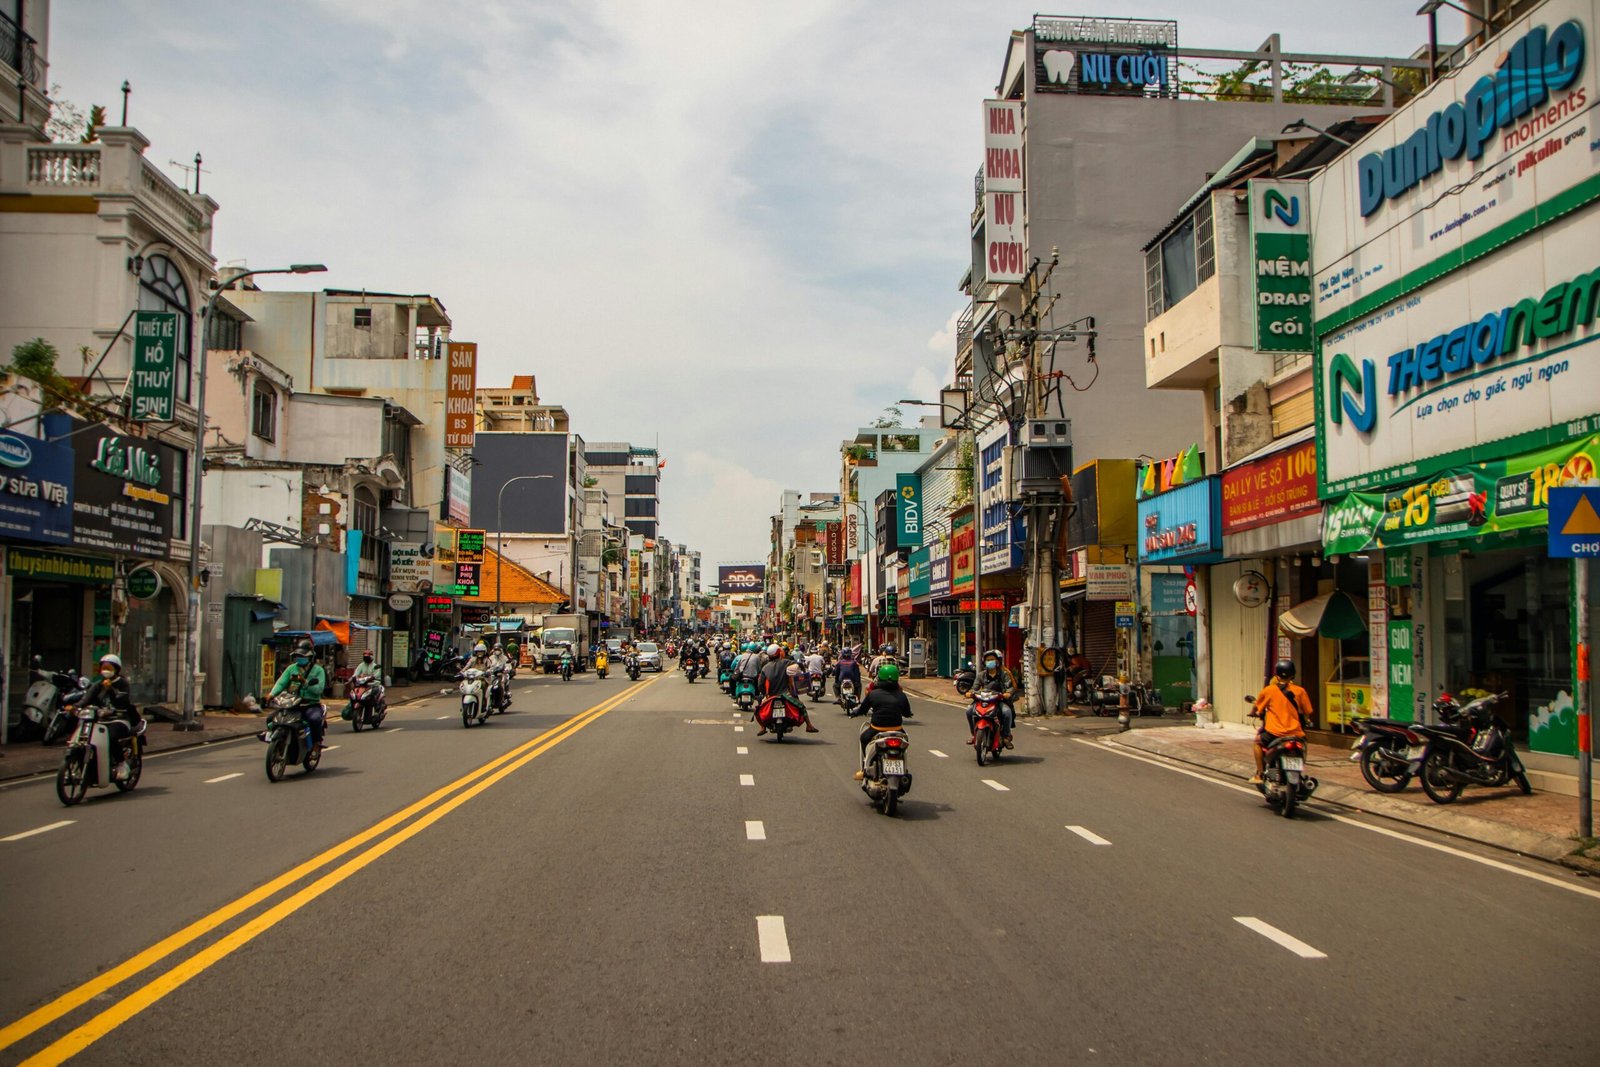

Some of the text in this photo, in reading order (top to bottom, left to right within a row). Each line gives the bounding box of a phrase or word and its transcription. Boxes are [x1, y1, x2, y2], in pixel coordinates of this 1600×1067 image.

[1082, 50, 1168, 89] NỤ CƯỜI
[989, 108, 1016, 134] NHA
[1358, 20, 1586, 218] Dunlopillo
[1504, 87, 1587, 152] moments
[986, 148, 1021, 178] KHOA
[1517, 137, 1562, 177] pikolin
[1564, 126, 1586, 146] group
[994, 194, 1015, 231] NỤ
[989, 235, 1024, 274] CƯỜI
[1258, 255, 1310, 278] NỆM
[1259, 291, 1311, 307] DRAP
[138, 317, 175, 337] THIẾT KẾ
[1269, 315, 1304, 335] GỐI
[144, 340, 164, 363] HỒ
[452, 346, 472, 368] SẢN
[136, 367, 171, 388] THUỶ
[451, 374, 472, 394] PHỤ
[1416, 360, 1569, 420] Lựa chọn cho giấc ngủ ngon
[136, 397, 168, 413] SINH
[448, 397, 474, 414] KHOA
[454, 418, 467, 429] BS
[447, 433, 460, 445] TỪ
[1287, 446, 1316, 480] 106
[9, 475, 39, 497] sữa
[42, 480, 69, 507] Việt
[1500, 478, 1529, 499] QUAY SỐ
[905, 500, 919, 534] BIDV
[1403, 484, 1430, 526] 15
[848, 513, 857, 549] vascara
[1571, 541, 1600, 556] CHỢ
[460, 564, 473, 572] SẢN
[1389, 552, 1408, 578] THẾ
[728, 574, 755, 588] PRO
[1391, 625, 1410, 650] GIỚI
[1391, 661, 1412, 688] NỆM
